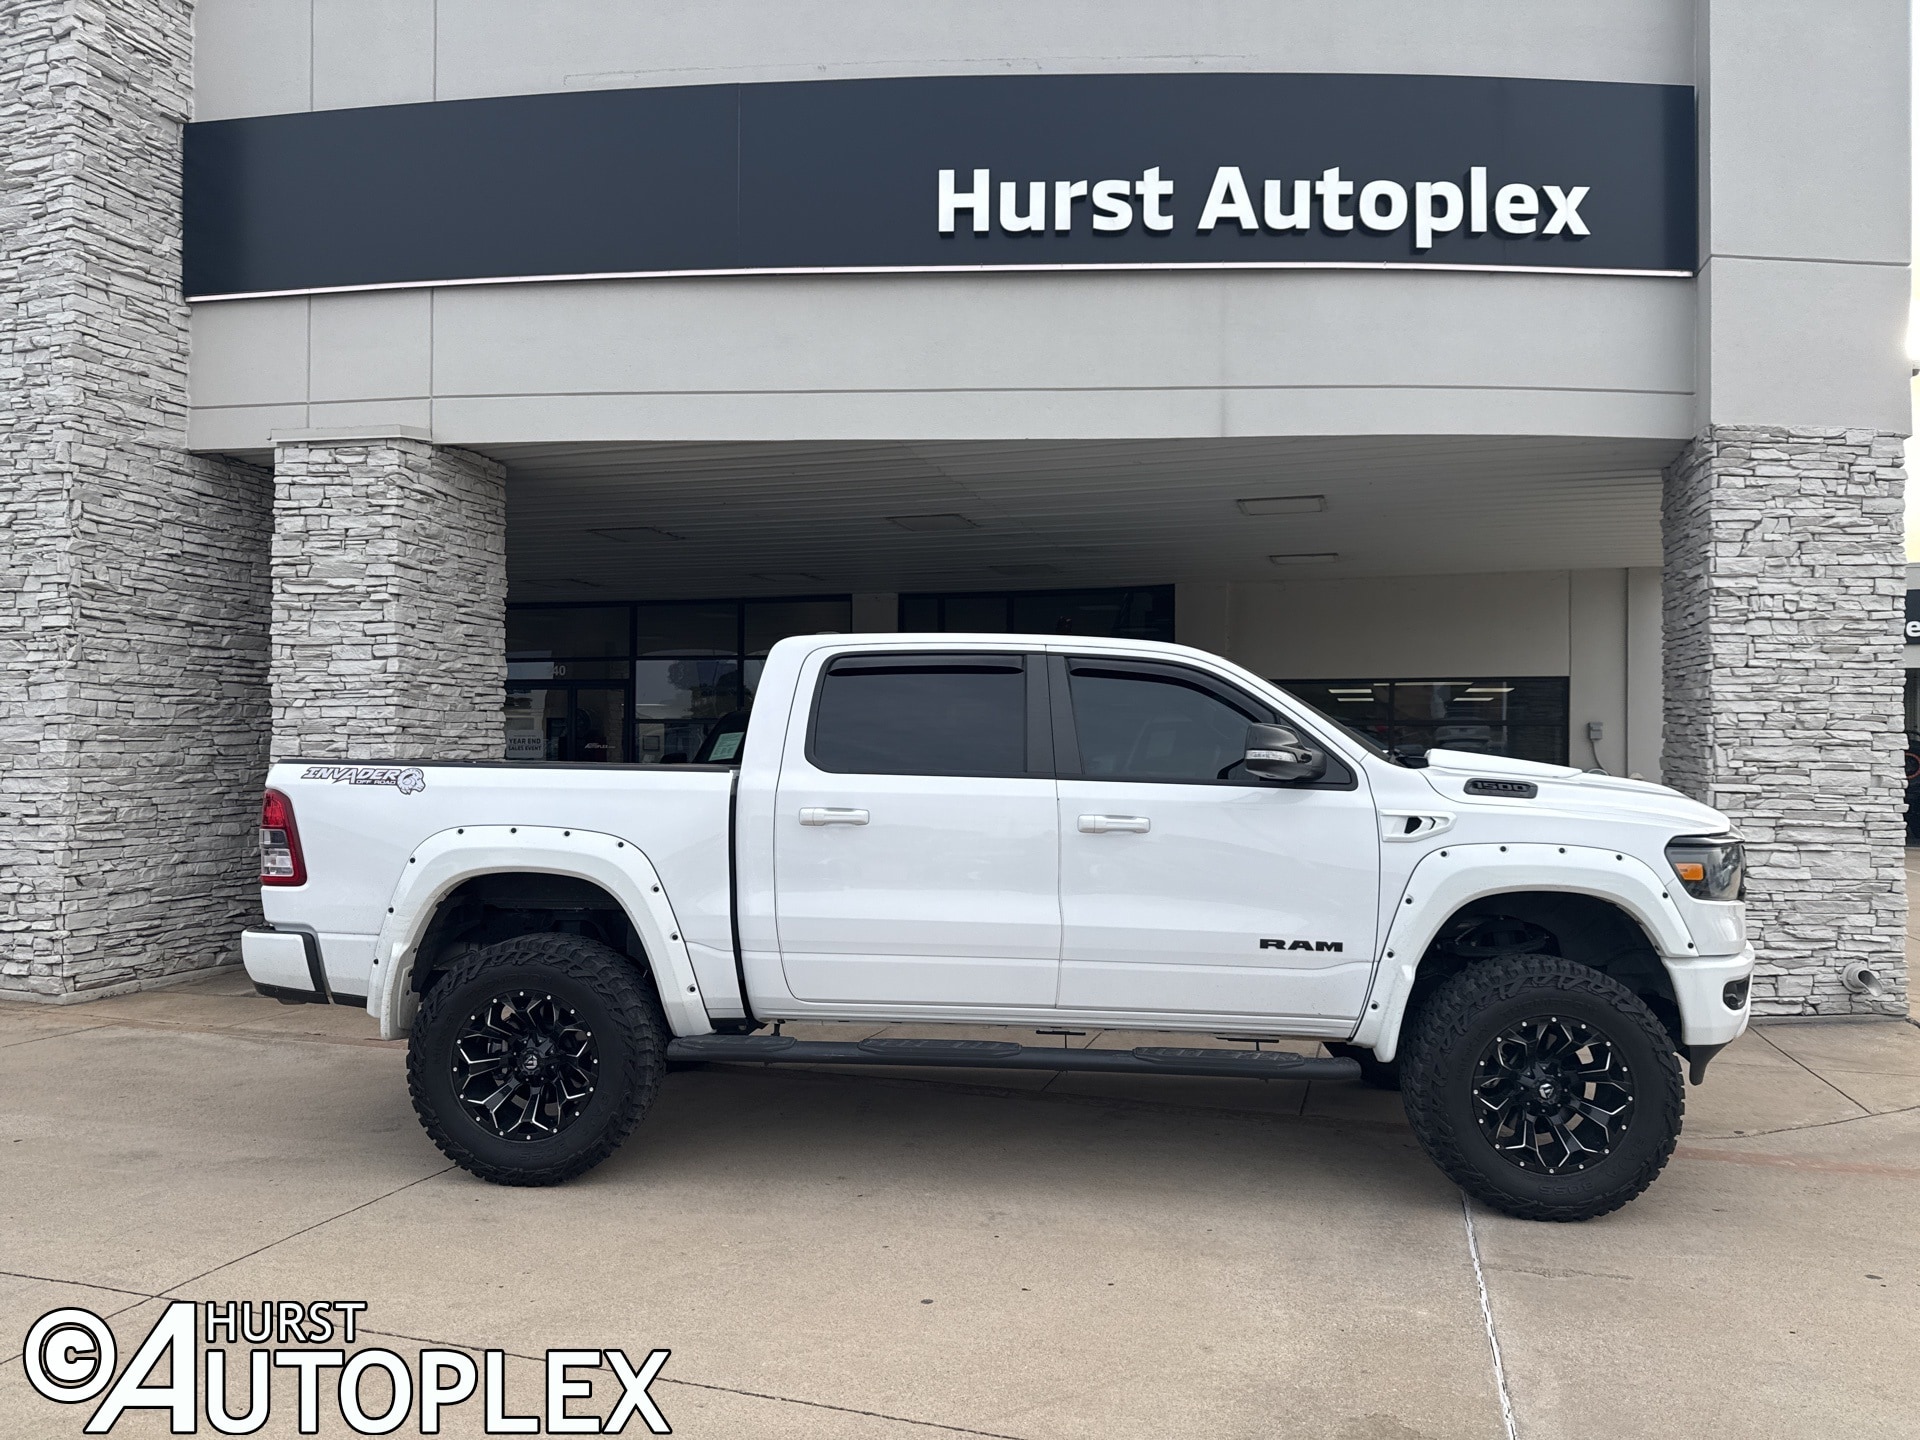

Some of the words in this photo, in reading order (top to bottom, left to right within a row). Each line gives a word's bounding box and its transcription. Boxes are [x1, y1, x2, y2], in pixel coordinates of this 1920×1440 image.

[937, 166, 1173, 234] Hurst
[1197, 166, 1591, 249] Autoplex
[301, 766, 402, 784] INVADER
[1473, 780, 1530, 793] 1500
[1259, 938, 1343, 953] RAM
